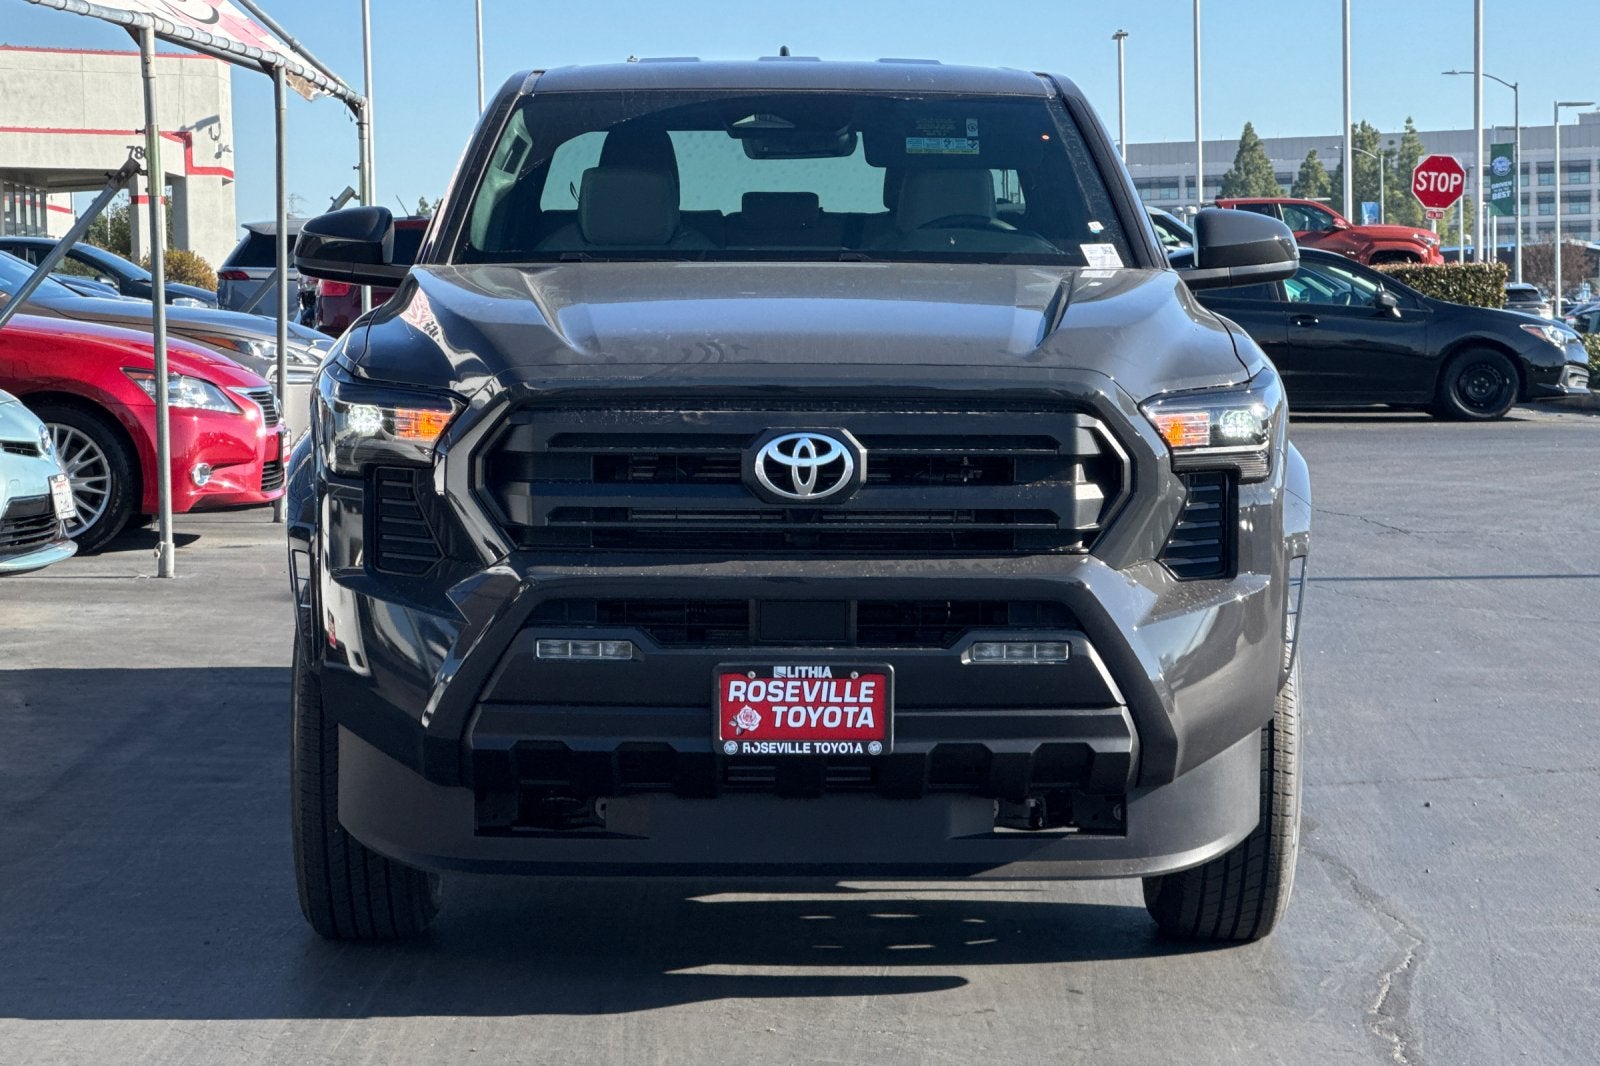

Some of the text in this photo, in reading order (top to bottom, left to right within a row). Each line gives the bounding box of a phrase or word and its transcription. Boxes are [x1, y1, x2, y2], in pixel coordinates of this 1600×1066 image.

[1415, 171, 1462, 193] STOP
[1492, 190, 1511, 200] BEST
[787, 666, 832, 678] LITHIA
[728, 681, 875, 702] ROSEVILLE
[772, 706, 875, 728] TOYOTA
[742, 742, 863, 754] ROSEVILLE TOYOTA
